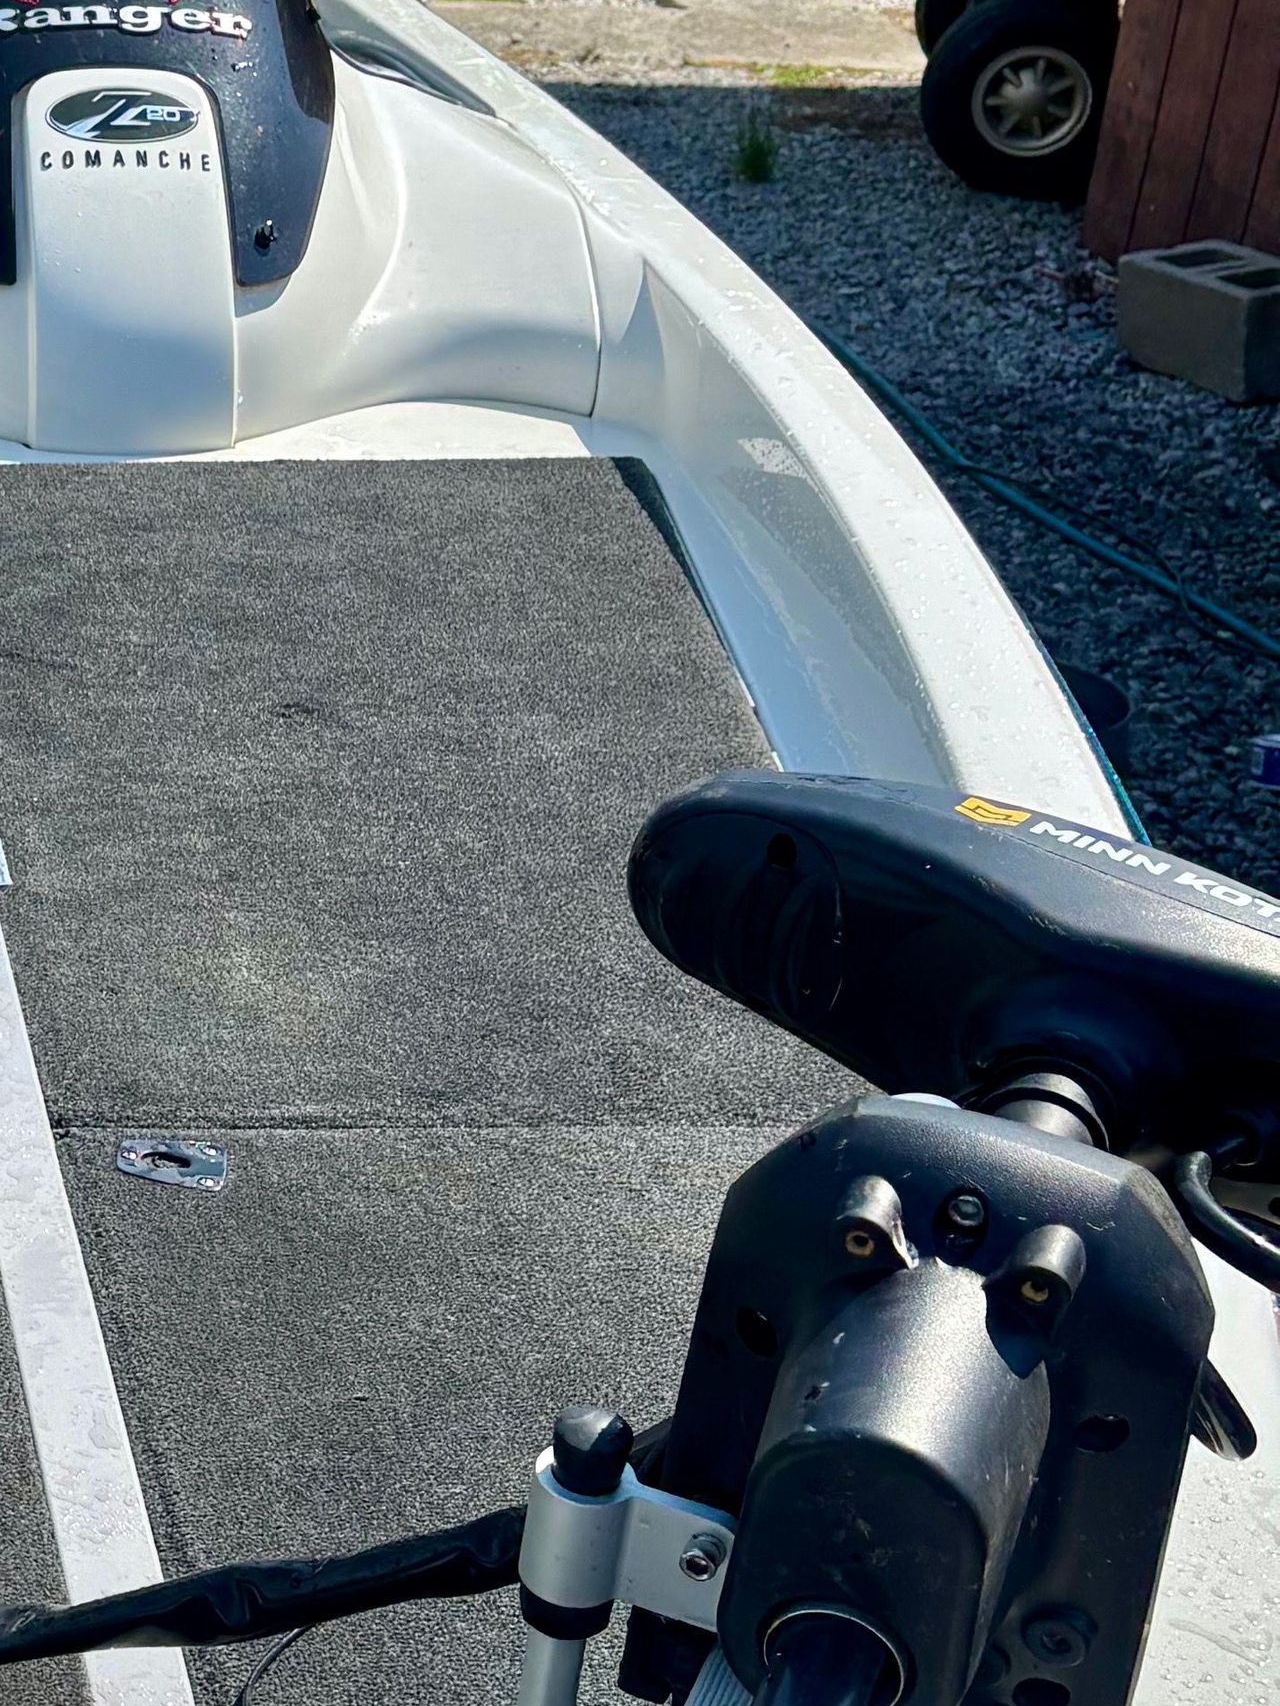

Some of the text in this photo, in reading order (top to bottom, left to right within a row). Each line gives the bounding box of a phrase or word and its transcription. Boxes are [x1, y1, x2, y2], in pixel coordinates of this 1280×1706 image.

[41, 149, 211, 172] COMANCHE
[1030, 821, 1280, 922] MINN KOT
